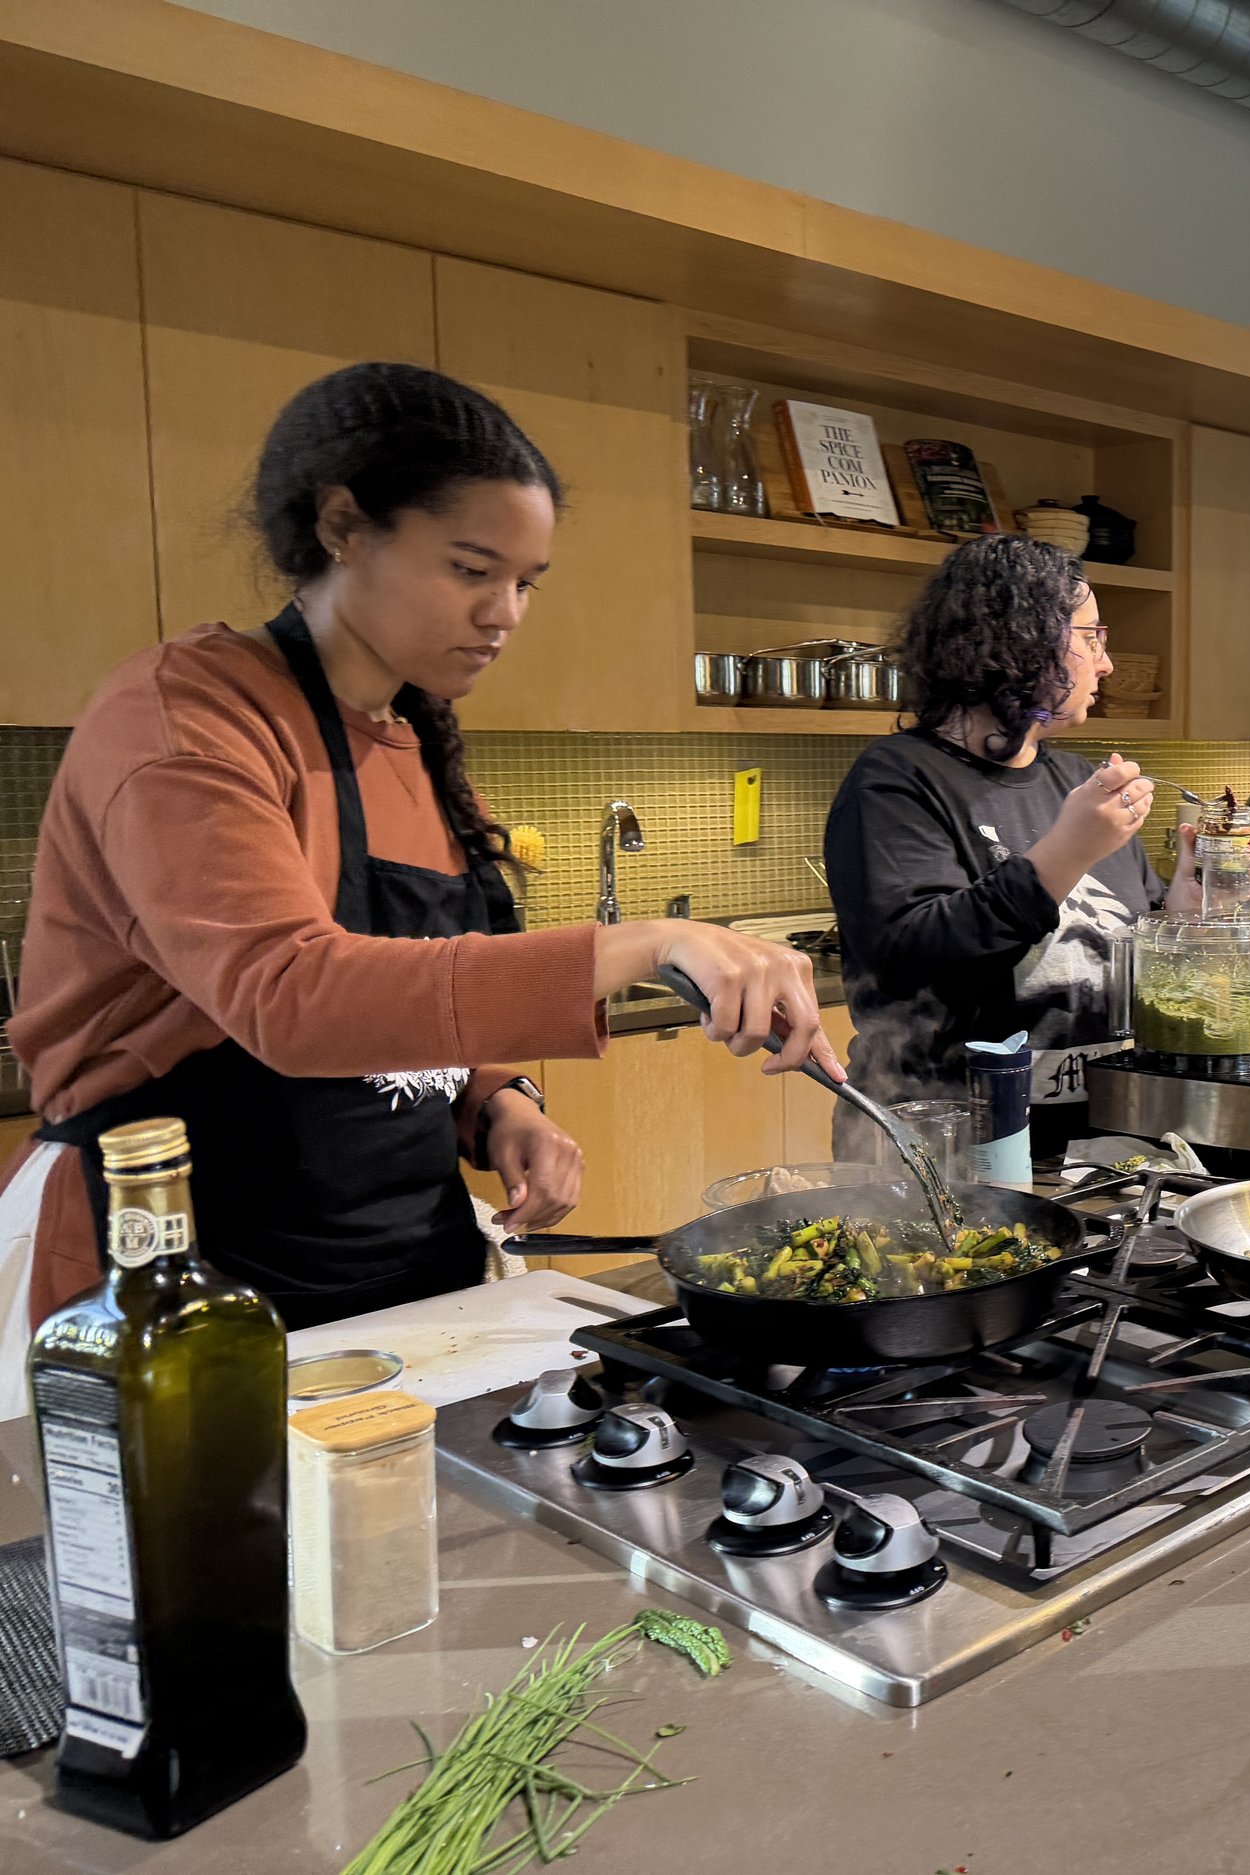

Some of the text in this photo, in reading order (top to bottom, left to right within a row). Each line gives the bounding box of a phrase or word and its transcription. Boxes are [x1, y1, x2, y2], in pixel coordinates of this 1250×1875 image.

[820, 424, 854, 443] THE
[820, 440, 865, 460] SPICE
[828, 456, 864, 474] COM
[820, 469, 877, 491] PANION
